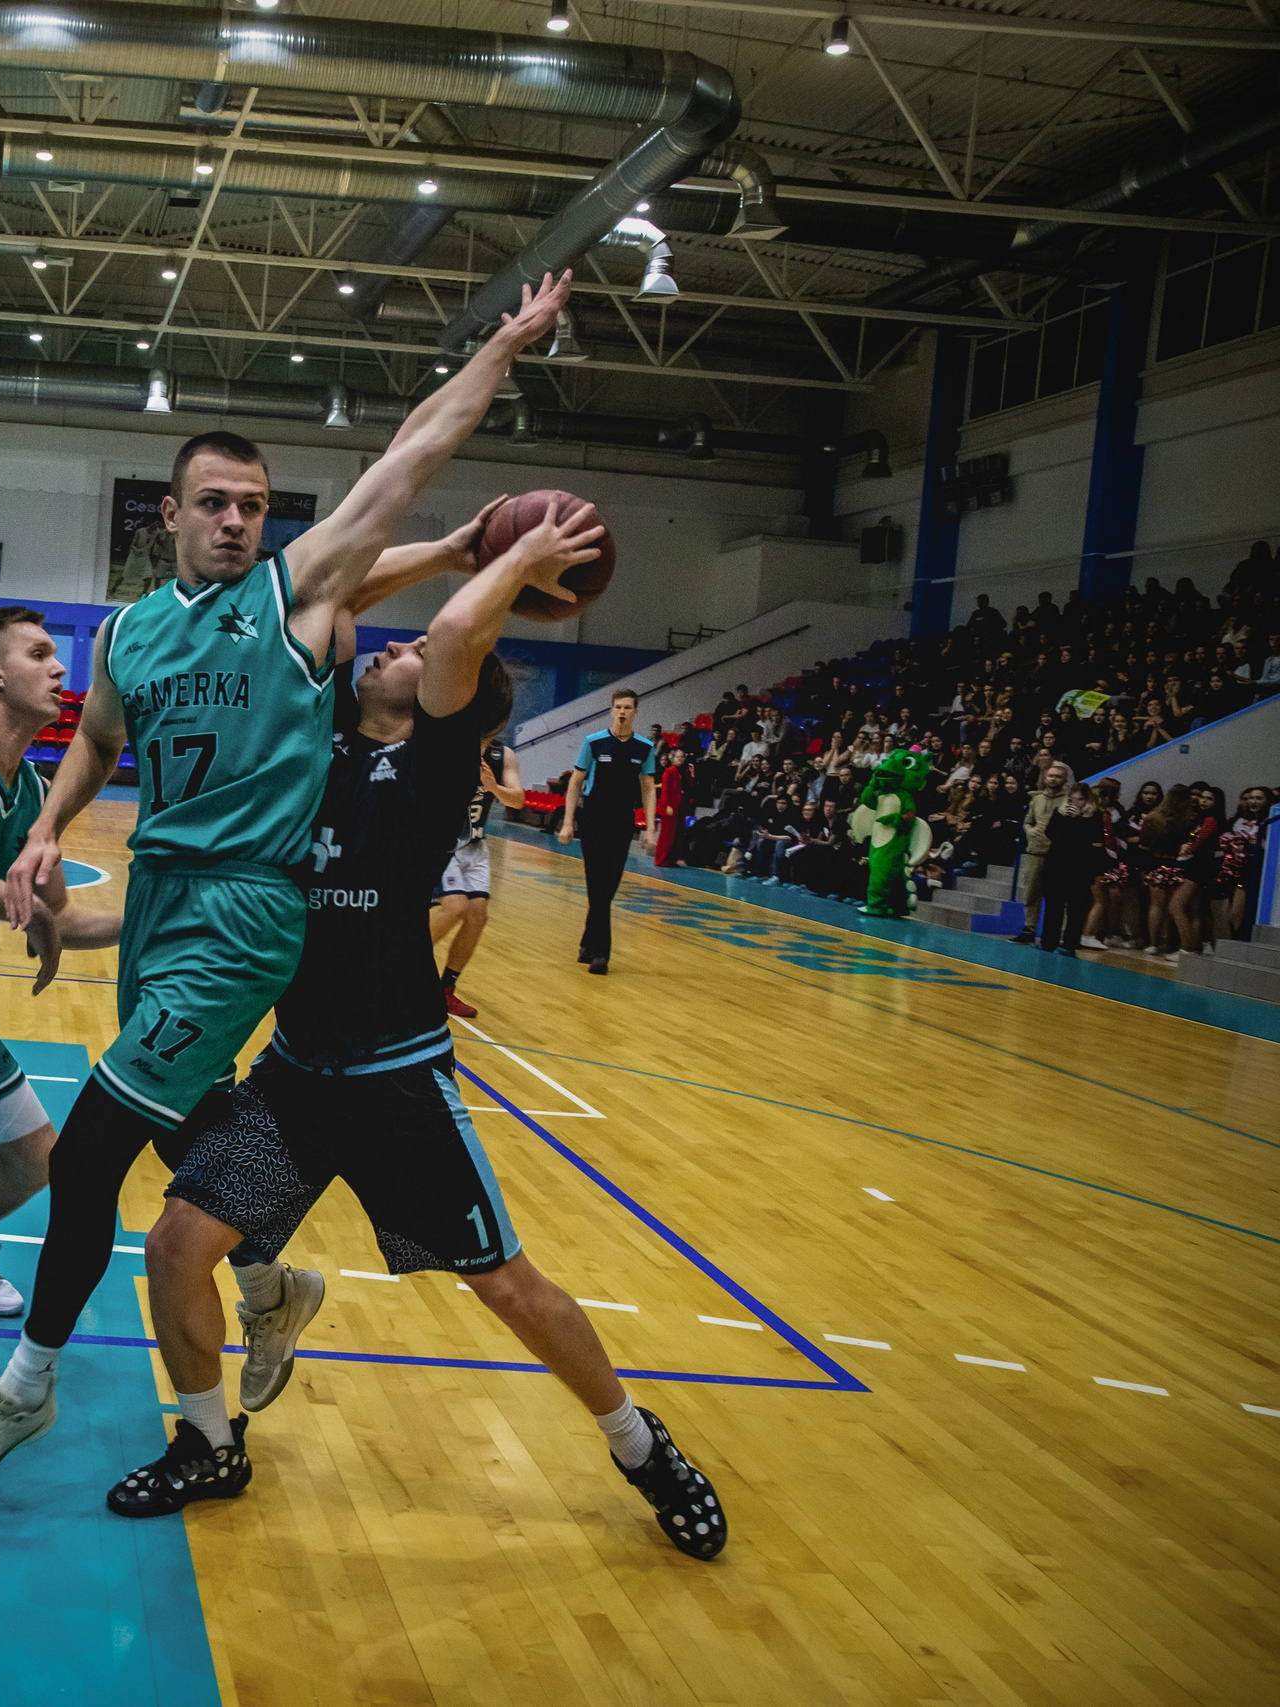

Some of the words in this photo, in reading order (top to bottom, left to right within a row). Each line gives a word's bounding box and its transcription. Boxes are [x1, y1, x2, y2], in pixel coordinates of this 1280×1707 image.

[146, 732, 218, 816] 17
[308, 887, 379, 912] group
[138, 1007, 206, 1065] 17
[466, 1204, 490, 1250] 1
